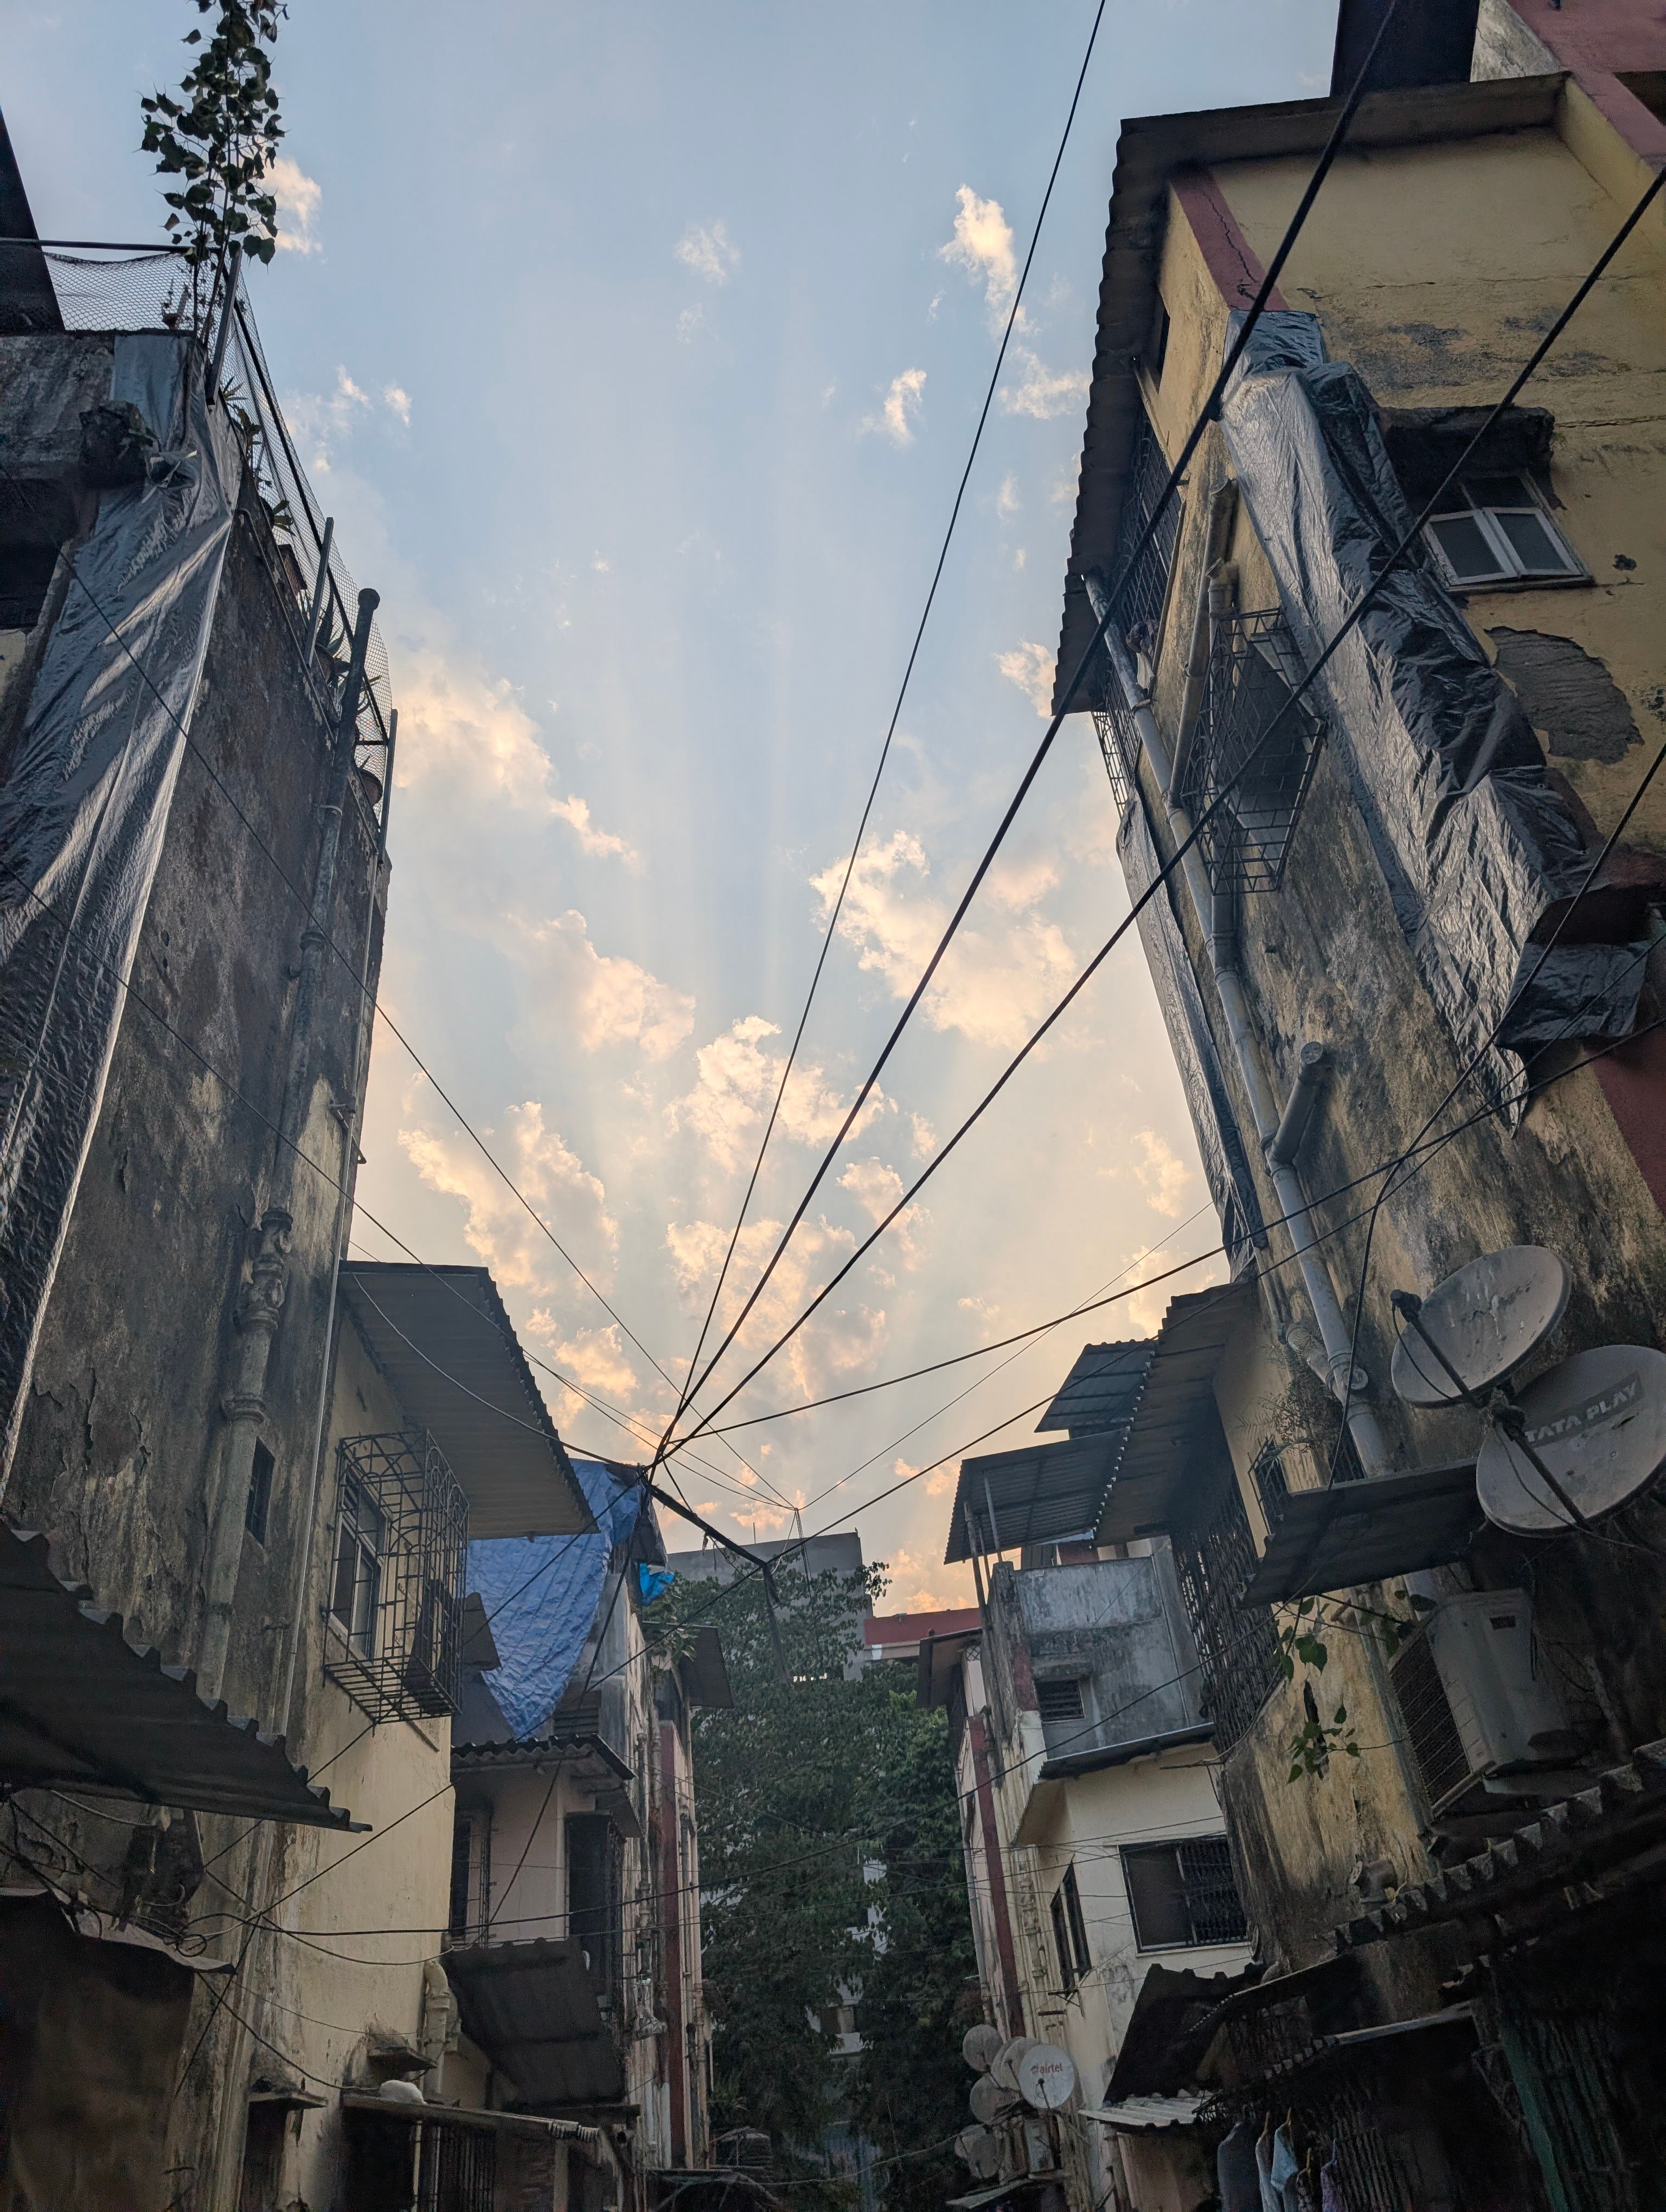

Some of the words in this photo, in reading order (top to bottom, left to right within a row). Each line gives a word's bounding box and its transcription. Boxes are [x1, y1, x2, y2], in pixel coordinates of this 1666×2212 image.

[1524, 1415, 1582, 1443] TATA
[1586, 1382, 1637, 1420] PLAY
[1040, 2062, 1063, 2074] airtel
